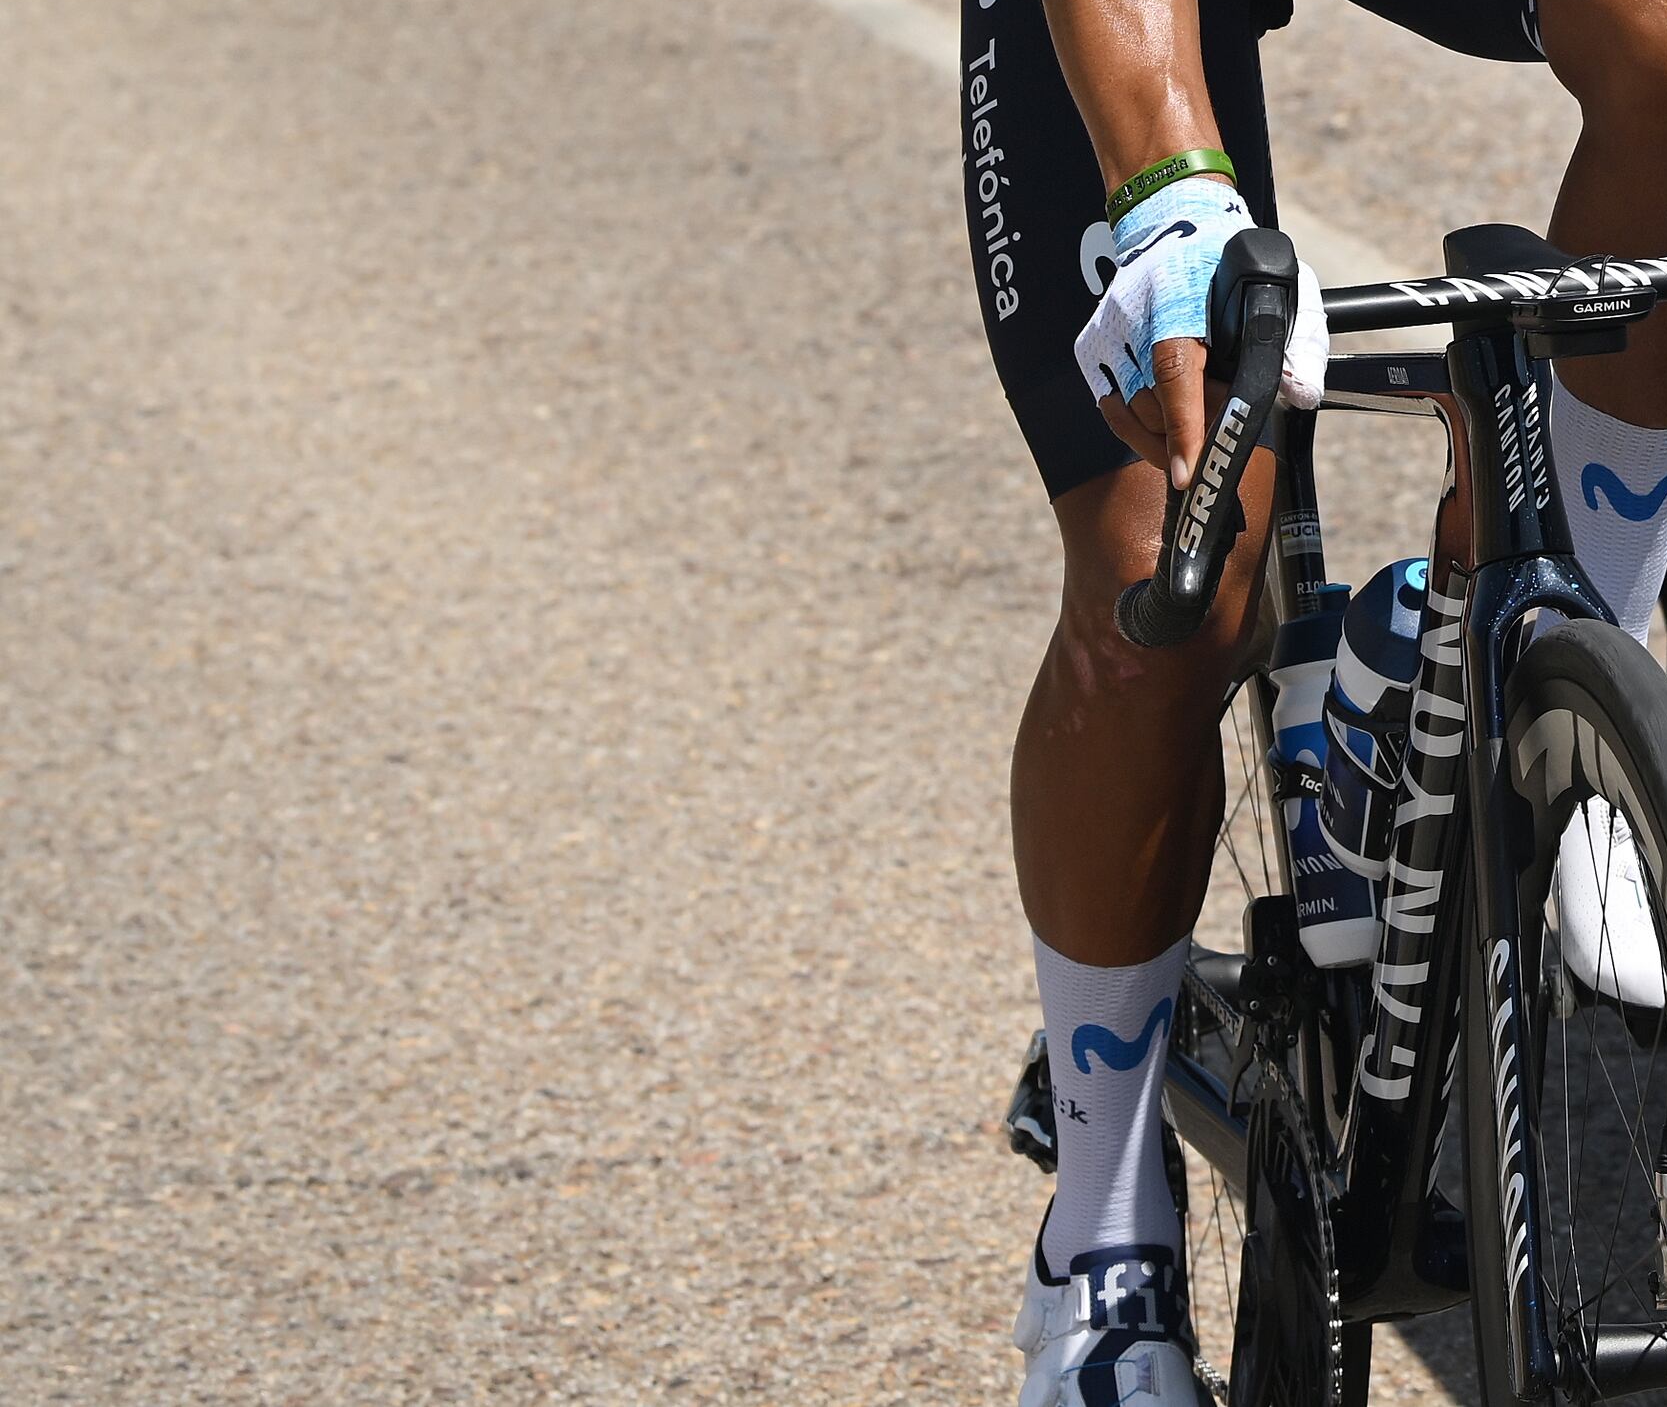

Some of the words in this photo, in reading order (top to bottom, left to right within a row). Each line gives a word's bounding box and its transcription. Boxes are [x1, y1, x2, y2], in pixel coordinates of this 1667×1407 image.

[968, 37, 1020, 322] Telefónica
[1572, 299, 1632, 314] GARMIN
[1178, 396, 1251, 559] SRAM
[1494, 383, 1526, 513] CANYON
[1521, 381, 1551, 511] CANYON
[1360, 588, 1467, 1100] CANYON
